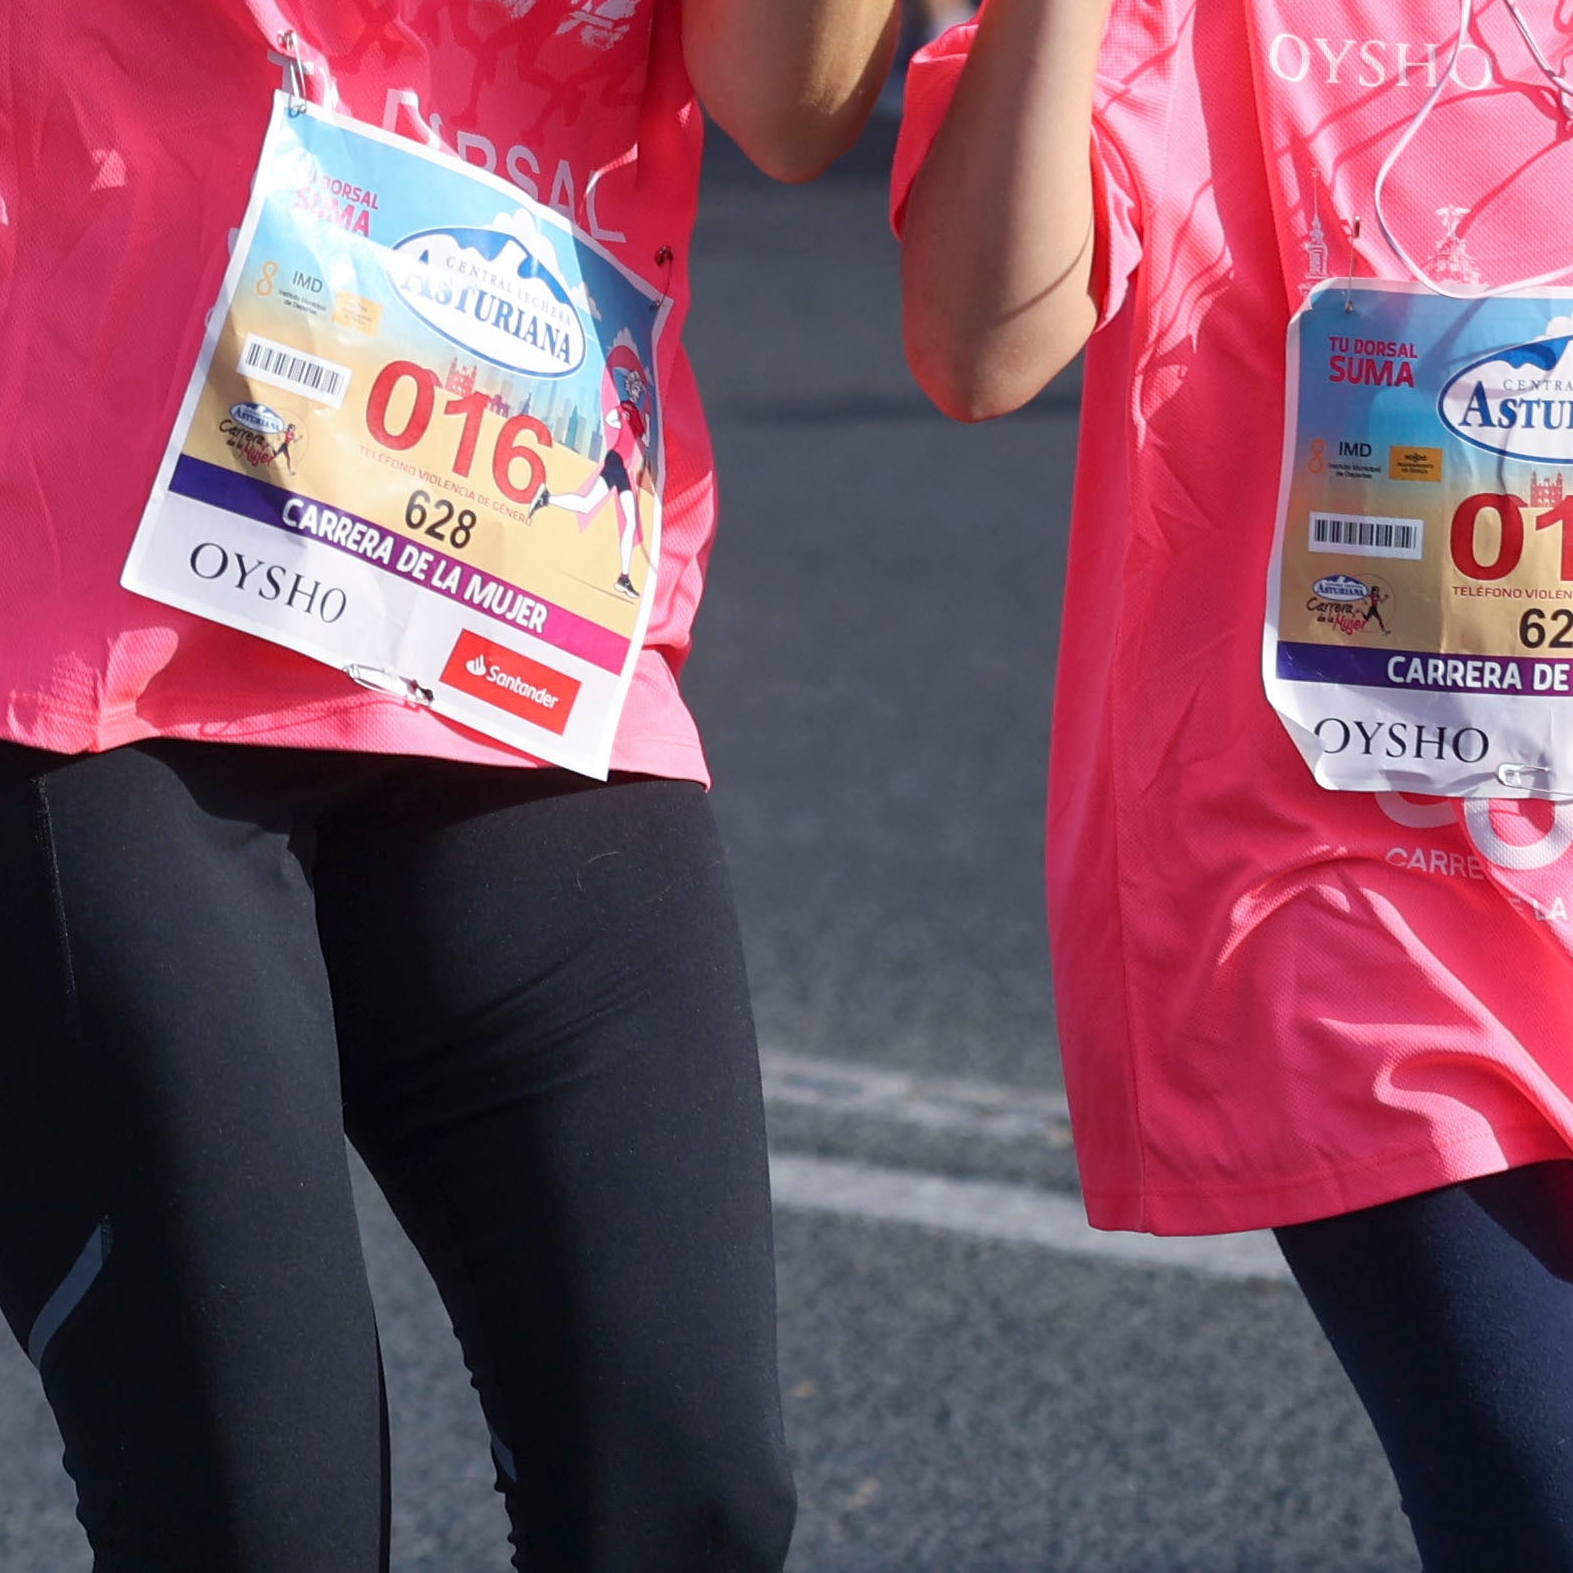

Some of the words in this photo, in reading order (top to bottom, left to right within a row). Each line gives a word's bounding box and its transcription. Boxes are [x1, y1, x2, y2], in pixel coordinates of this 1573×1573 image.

[1270, 33, 1494, 90] OYSHO
[292, 271, 323, 293] IMD
[446, 256, 512, 293] CENTRAL
[517, 289, 571, 325] LECHERA
[401, 249, 572, 365] ASTURIANA
[1330, 336, 1351, 354] TU
[1354, 338, 1418, 359] DORSAL
[1329, 356, 1414, 388] SUMA
[365, 359, 554, 505] 016
[1339, 441, 1372, 458] IMD
[360, 445, 416, 475] TELÉFONO
[419, 469, 475, 501] VIOLENCIA
[478, 494, 490, 507] DE
[492, 500, 533, 527] GÉNERO
[405, 489, 477, 549] 628
[189, 542, 348, 624] OYSHO
[281, 499, 392, 565] CARRERA
[396, 544, 433, 580] DE
[430, 558, 460, 593] LA
[463, 574, 549, 634] MUJER
[1307, 597, 1354, 613] Carrera
[1453, 586, 1521, 599] TELÉFONO
[485, 664, 560, 710] Santander
[1387, 655, 1523, 691] CARRERA
[1532, 660, 1569, 692] DE
[1314, 716, 1489, 764] OYSHO
[1385, 847, 1486, 880] CARRE
